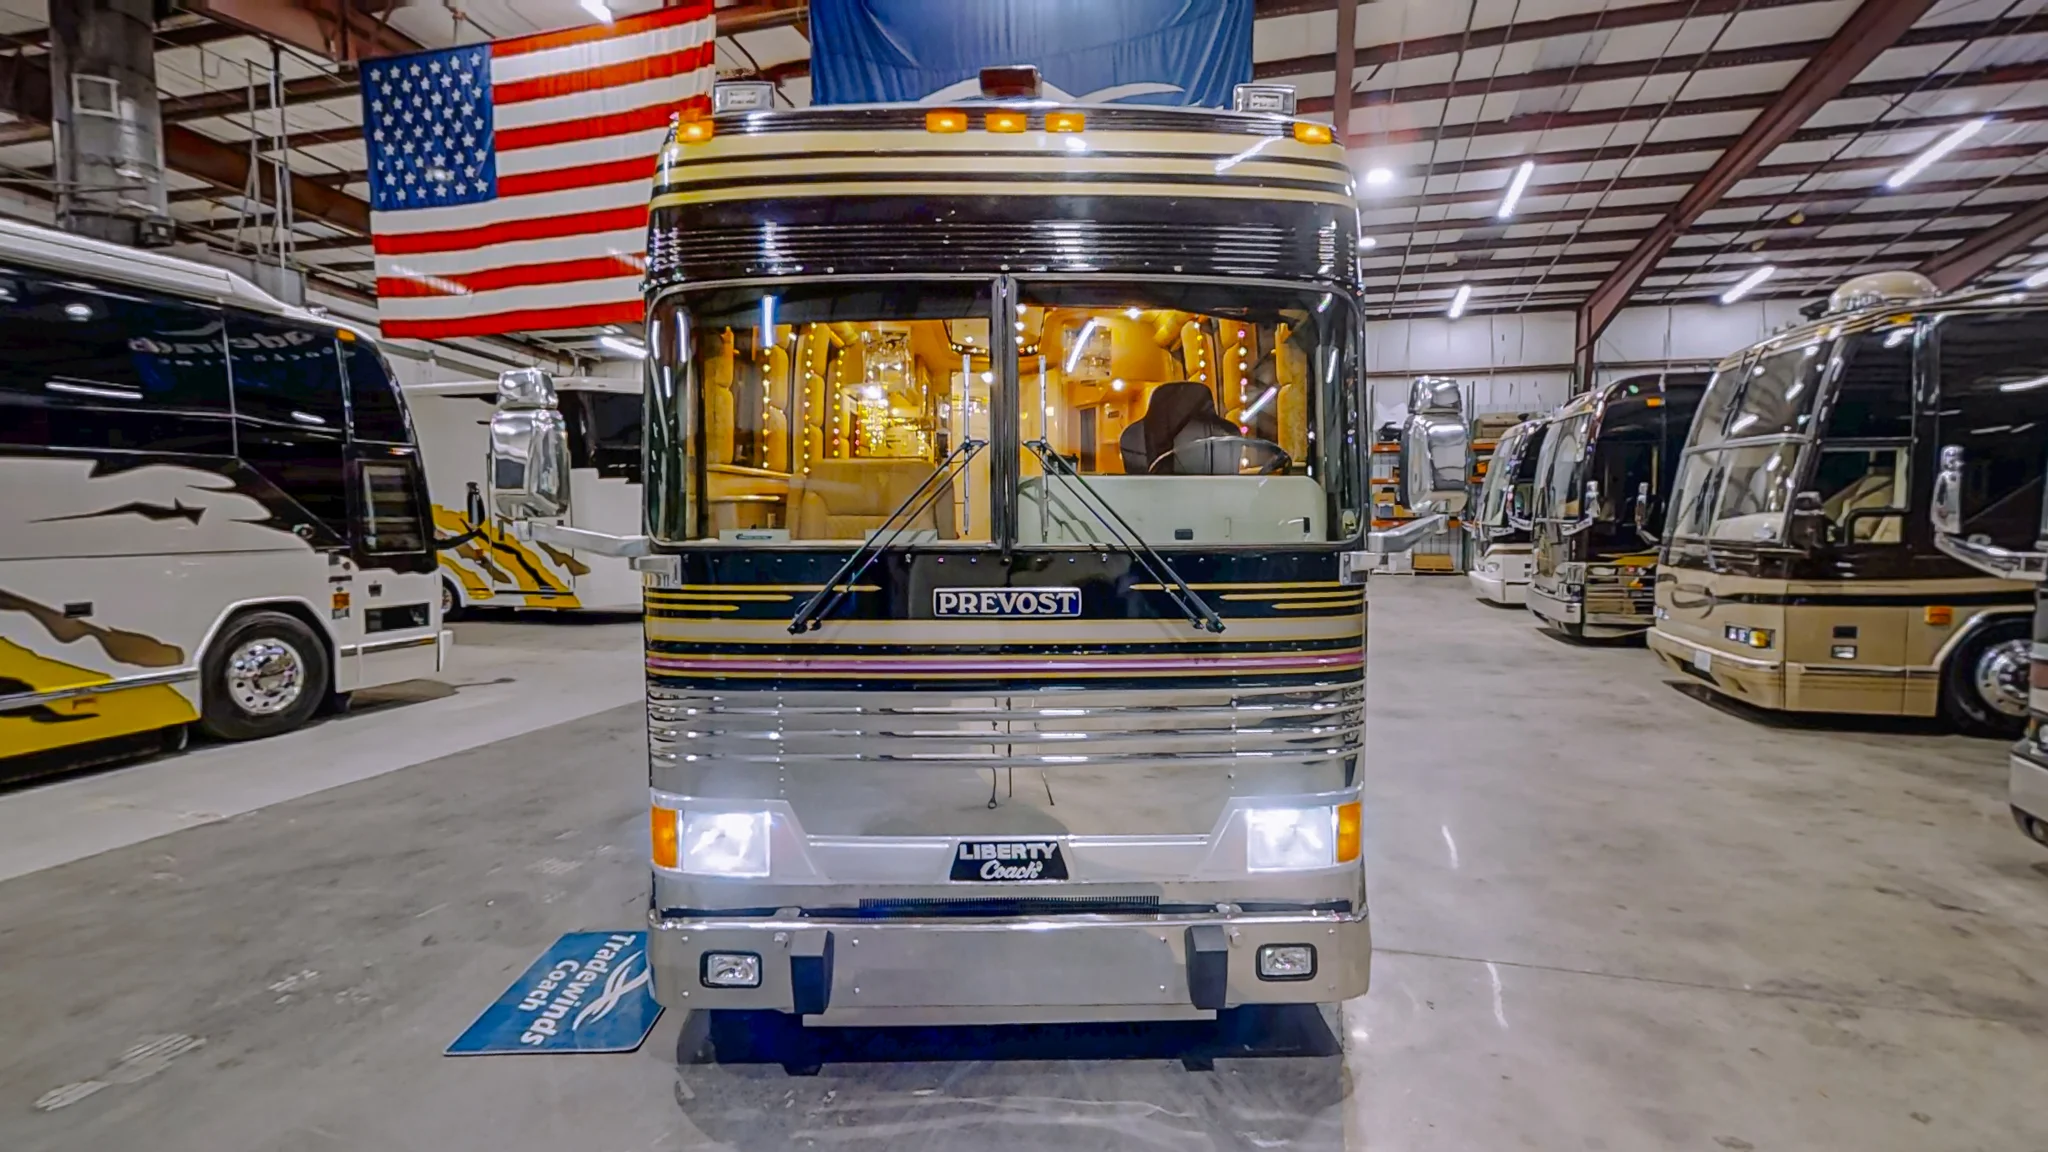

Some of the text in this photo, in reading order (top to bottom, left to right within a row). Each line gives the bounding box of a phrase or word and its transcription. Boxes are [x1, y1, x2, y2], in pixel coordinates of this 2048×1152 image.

[938, 592, 1077, 614] PREVOST
[959, 843, 1058, 860] LIBERTY
[518, 959, 580, 1011] Coach
[520, 934, 637, 1046] Tradewinds
